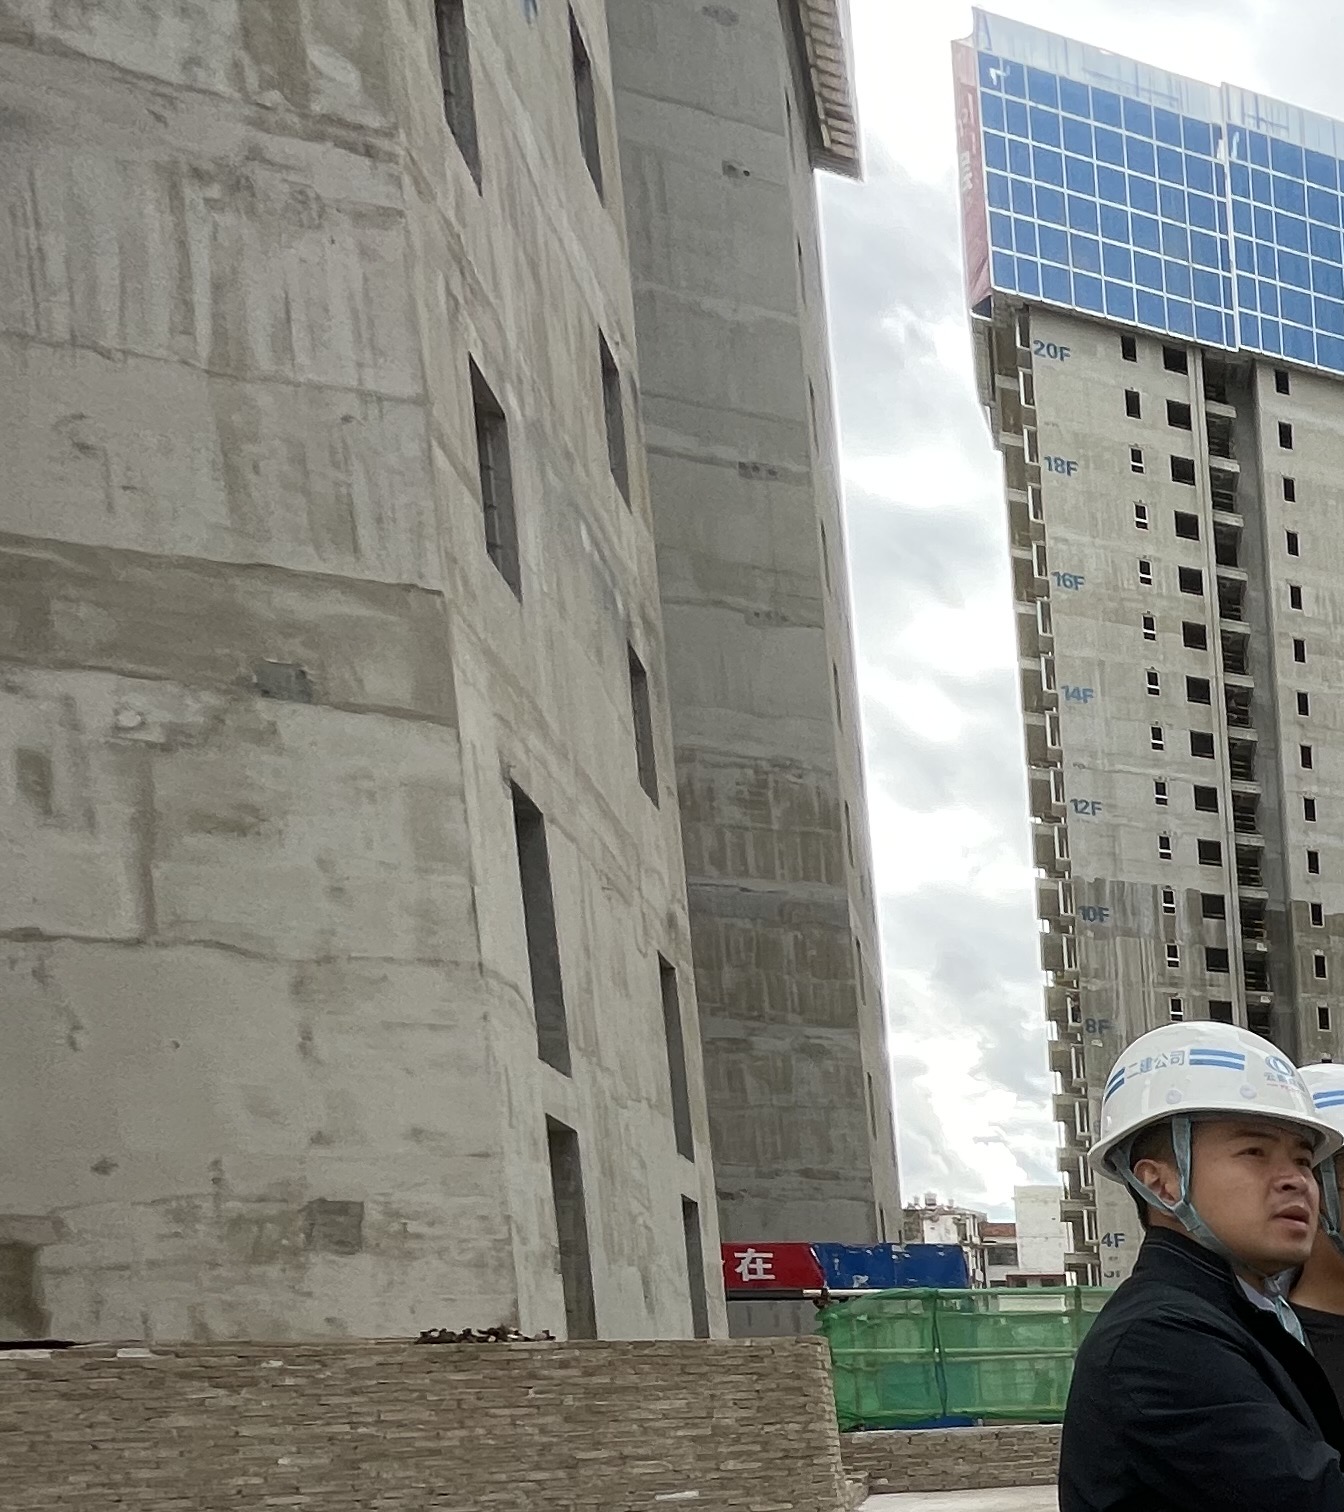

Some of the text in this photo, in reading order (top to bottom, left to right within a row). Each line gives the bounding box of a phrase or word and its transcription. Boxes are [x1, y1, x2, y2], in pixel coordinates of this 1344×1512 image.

[1033, 340, 1071, 362] 20F
[1044, 456, 1079, 477] 18F
[1051, 571, 1085, 592] 16F
[1061, 685, 1094, 704] 14F
[1070, 798, 1102, 817] 12F
[1078, 906, 1110, 923] 10F
[1085, 1018, 1111, 1036] 8F
[1101, 1232, 1126, 1249] 4F
[734, 1247, 776, 1282] 在
